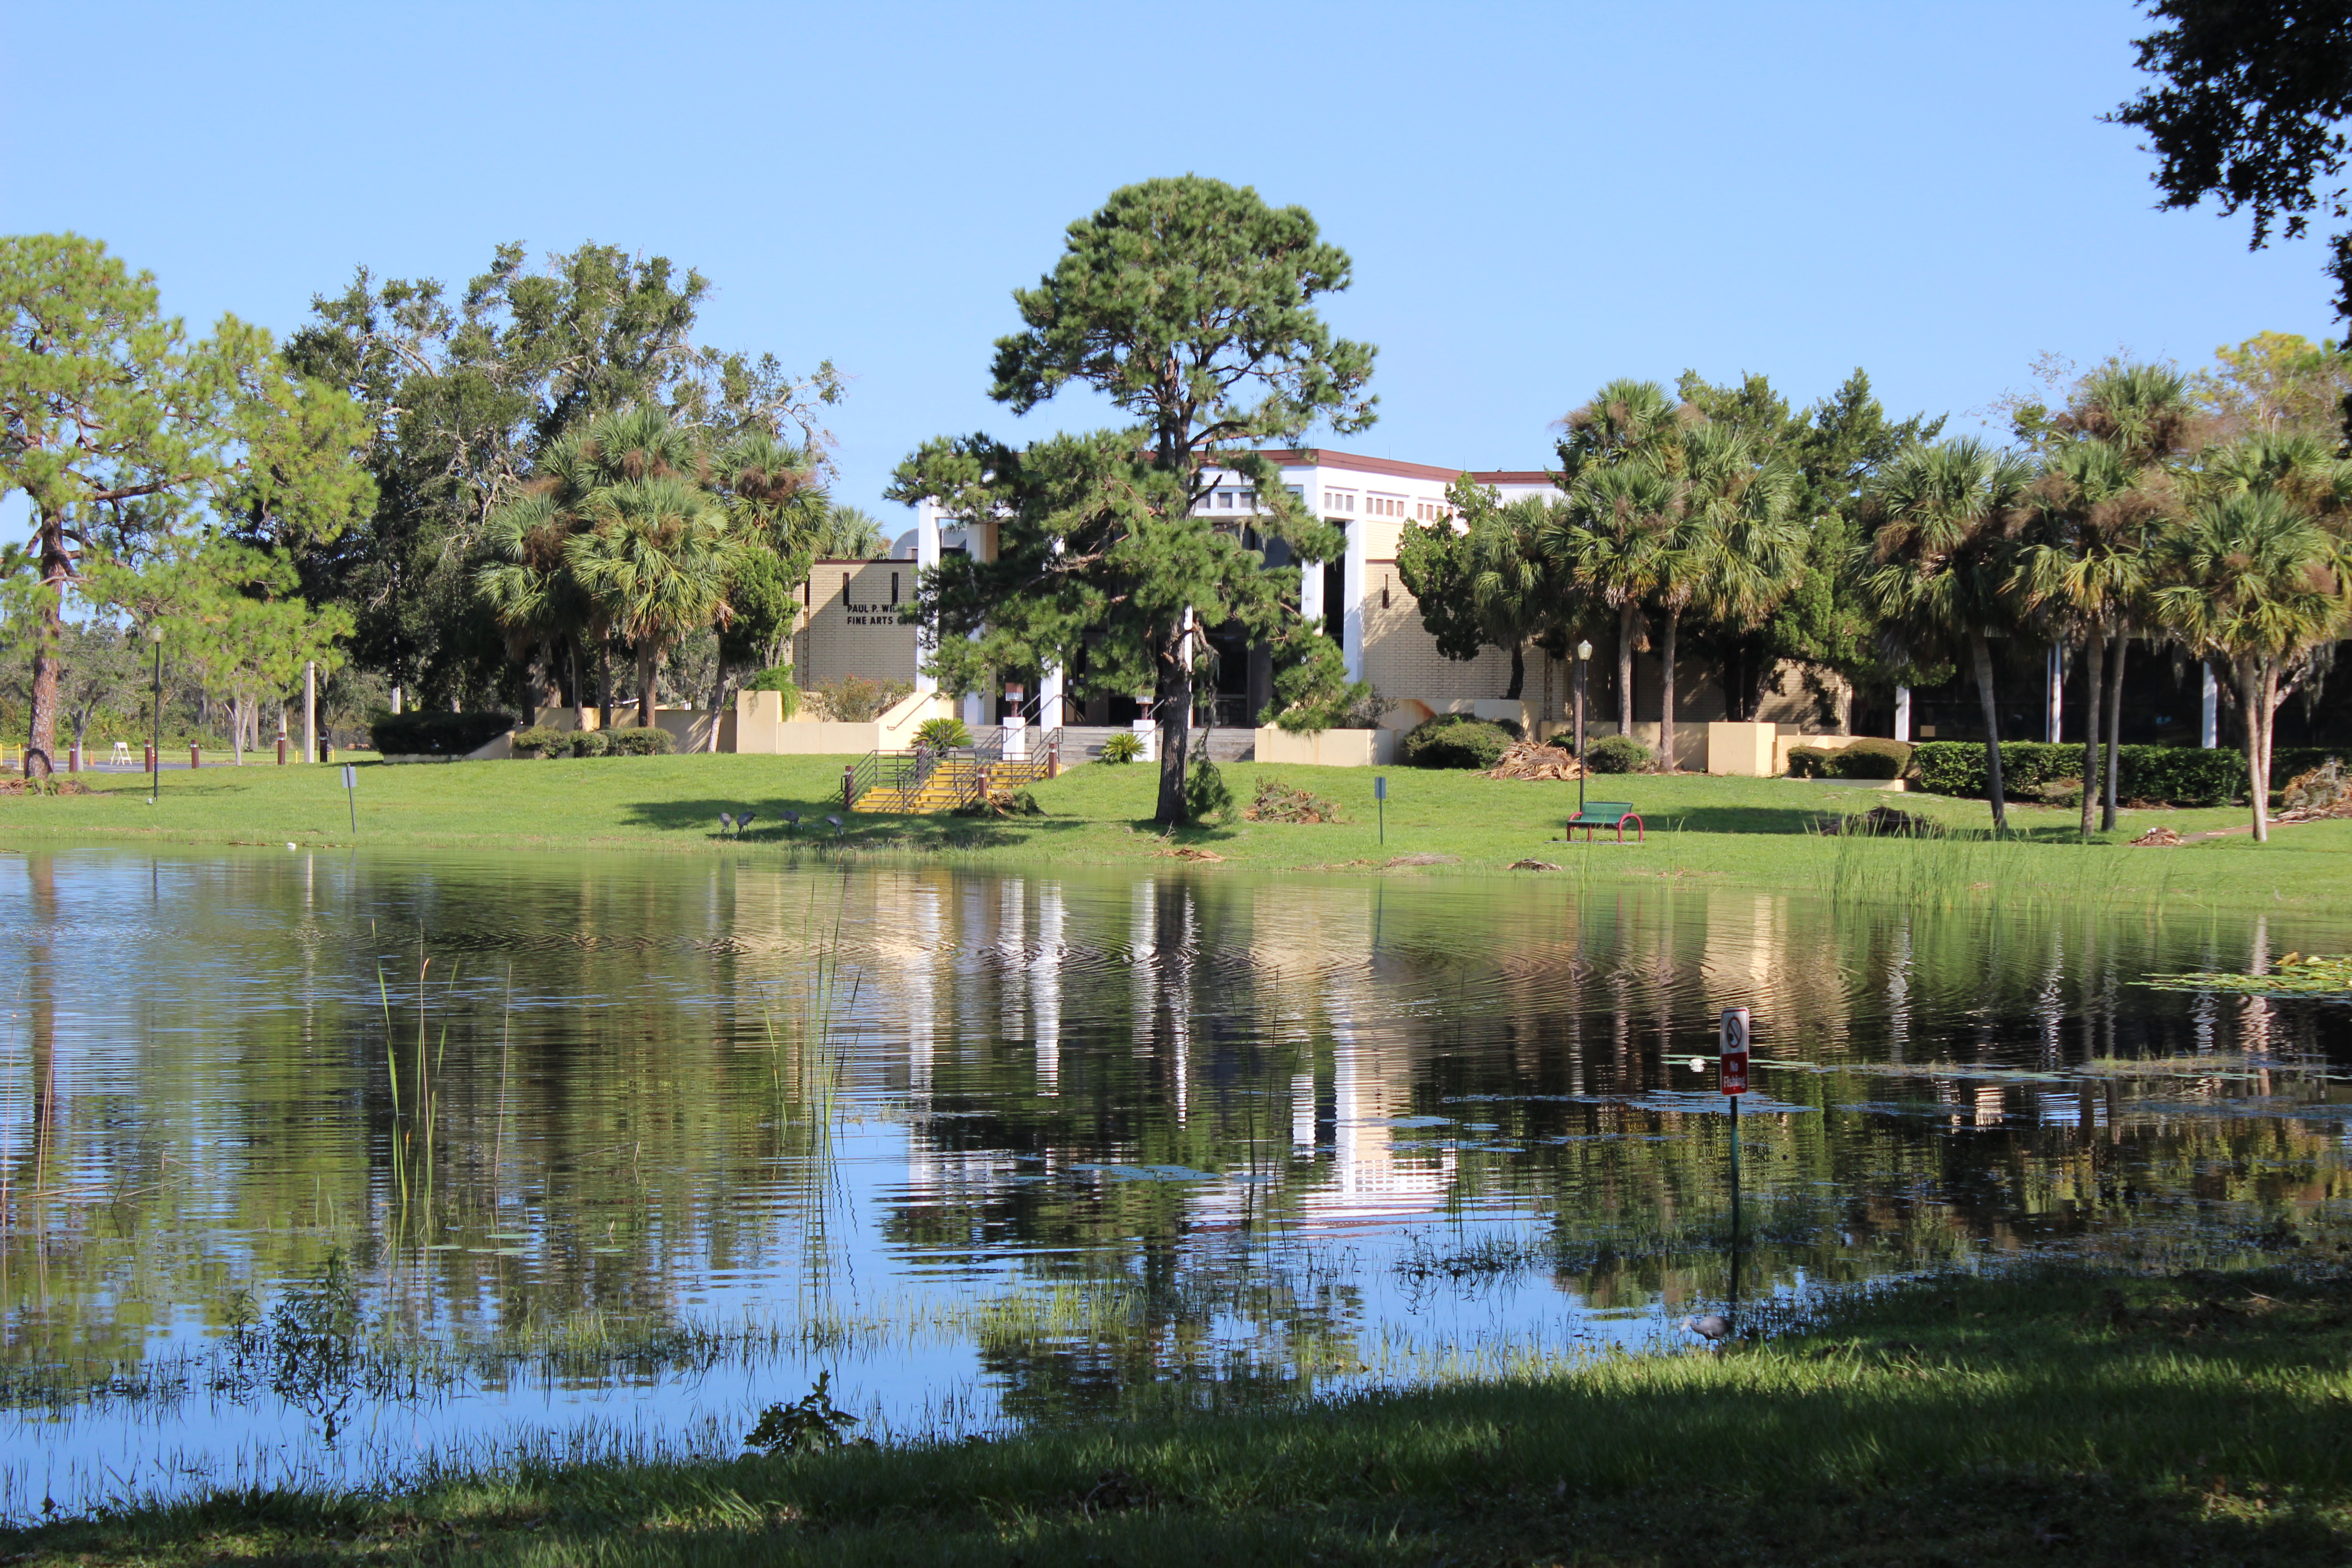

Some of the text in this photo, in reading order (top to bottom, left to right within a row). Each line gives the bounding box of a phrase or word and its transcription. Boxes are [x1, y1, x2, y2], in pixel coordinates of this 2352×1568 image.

[848, 617, 867, 625] FINE
[870, 617, 893, 625] ARTS
[1730, 1061, 1738, 1072] No
[1724, 1075, 1745, 1088] Fishing
